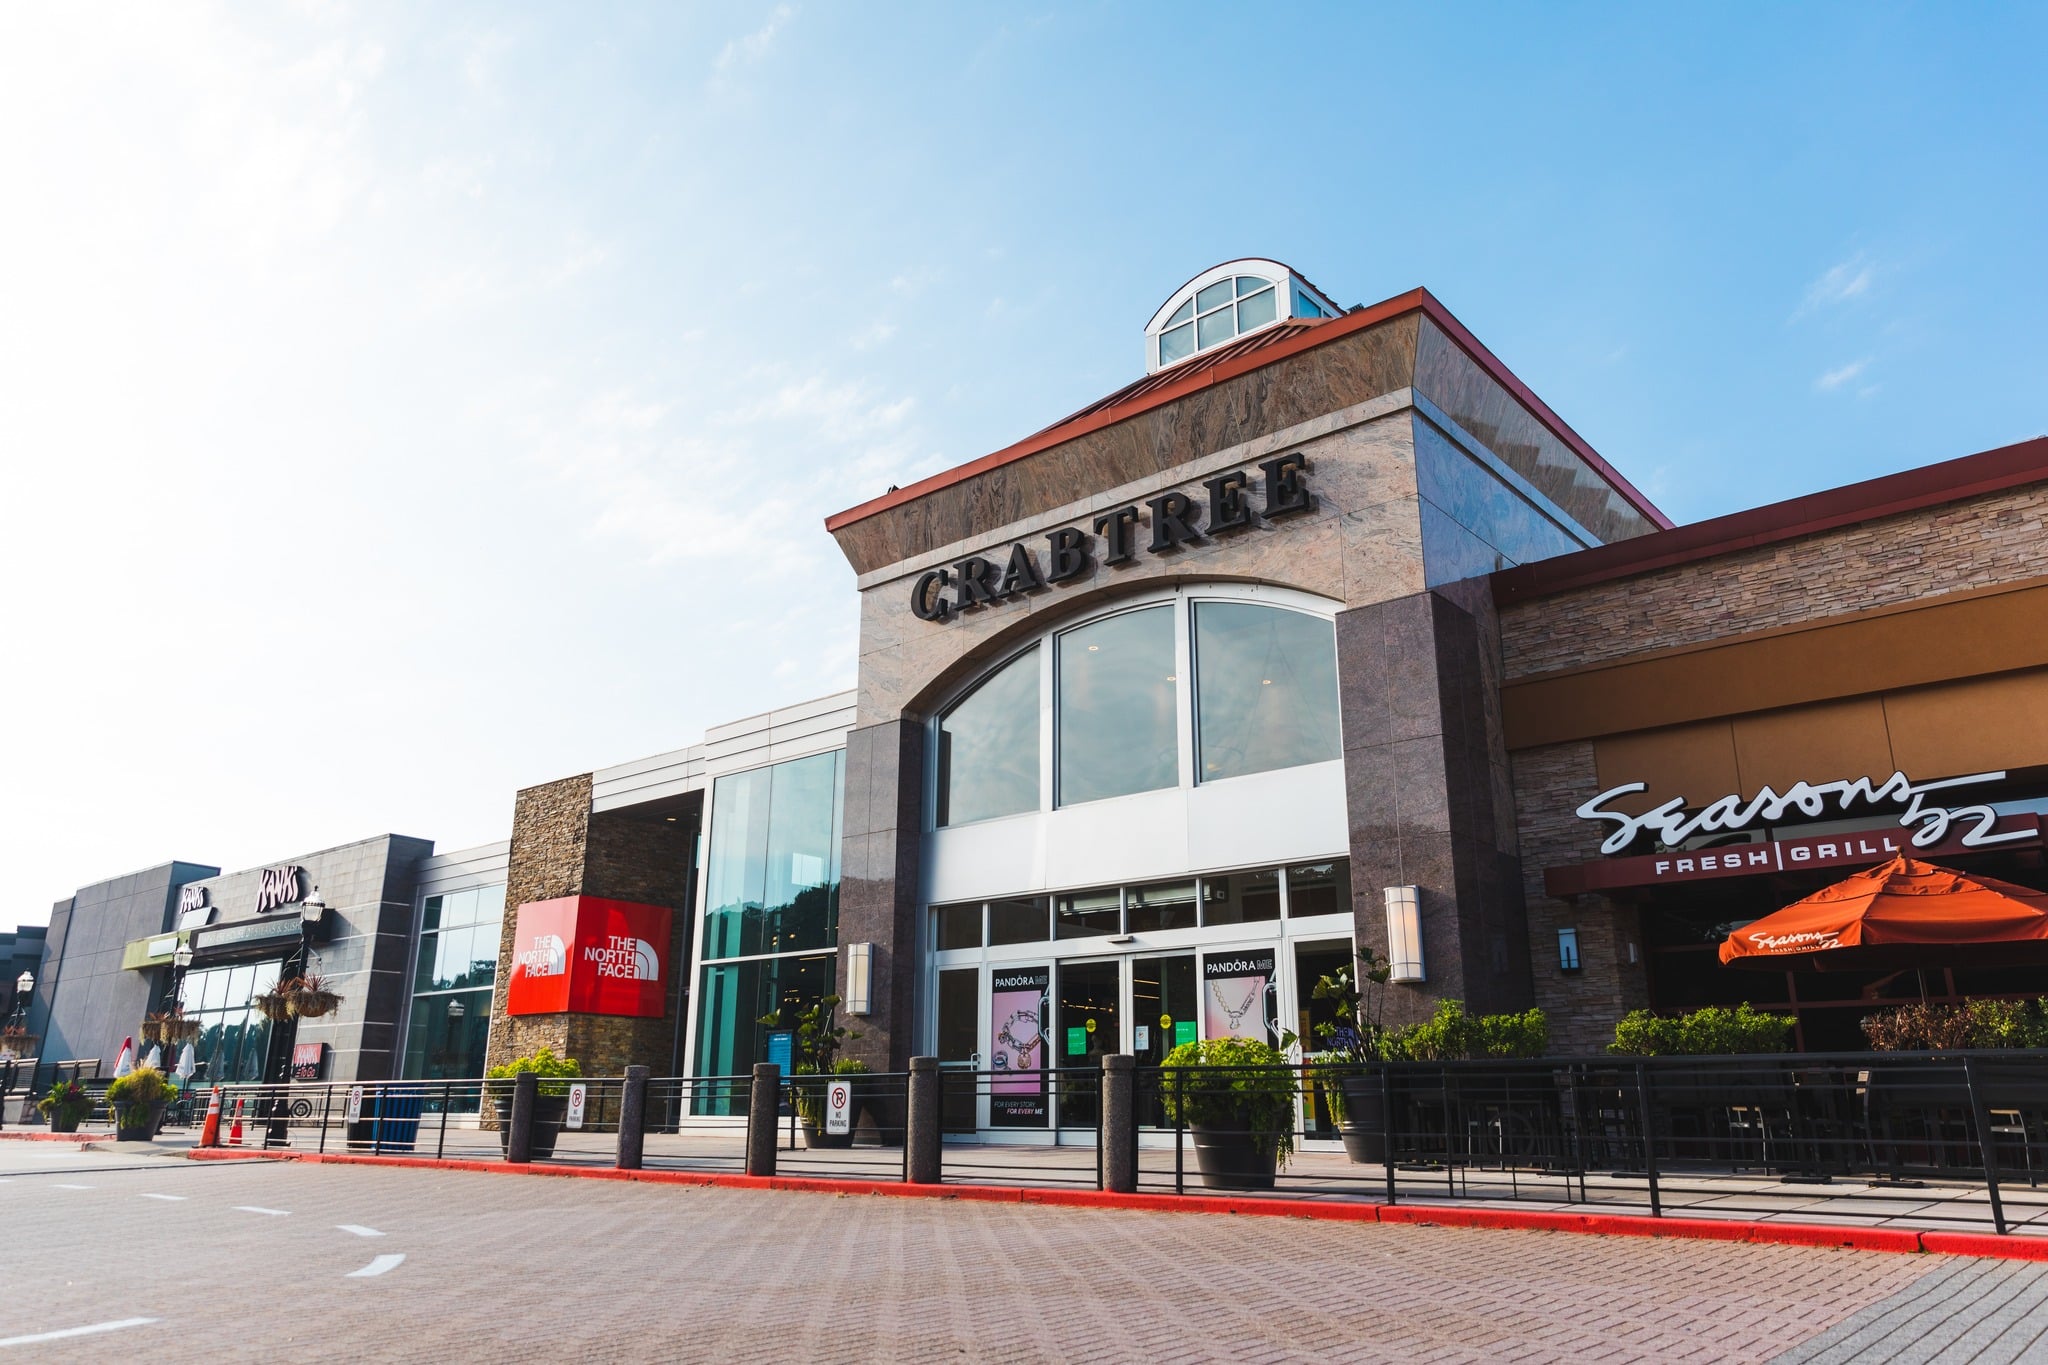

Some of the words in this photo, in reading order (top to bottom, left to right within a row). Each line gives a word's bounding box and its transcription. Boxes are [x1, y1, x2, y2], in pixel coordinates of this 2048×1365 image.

[911, 452, 1316, 622] CRABTREE
[1575, 770, 2006, 855] Seasons
[1899, 793, 2039, 848] 52
[1655, 849, 1769, 876] FRESH
[1790, 837, 1900, 862] GRILL
[534, 935, 551, 949] THE
[608, 935, 636, 951] THE
[518, 949, 549, 965] NORTH
[584, 947, 634, 966] NORTH
[1256, 959, 1273, 970] ME
[525, 962, 549, 979] FACE
[597, 962, 633, 980] FACE
[1006, 1107, 1017, 1115] FOR
[1018, 1107, 1034, 1115] EVERY
[1034, 1107, 1043, 1115] ME
[829, 1119, 847, 1128] PARKING
